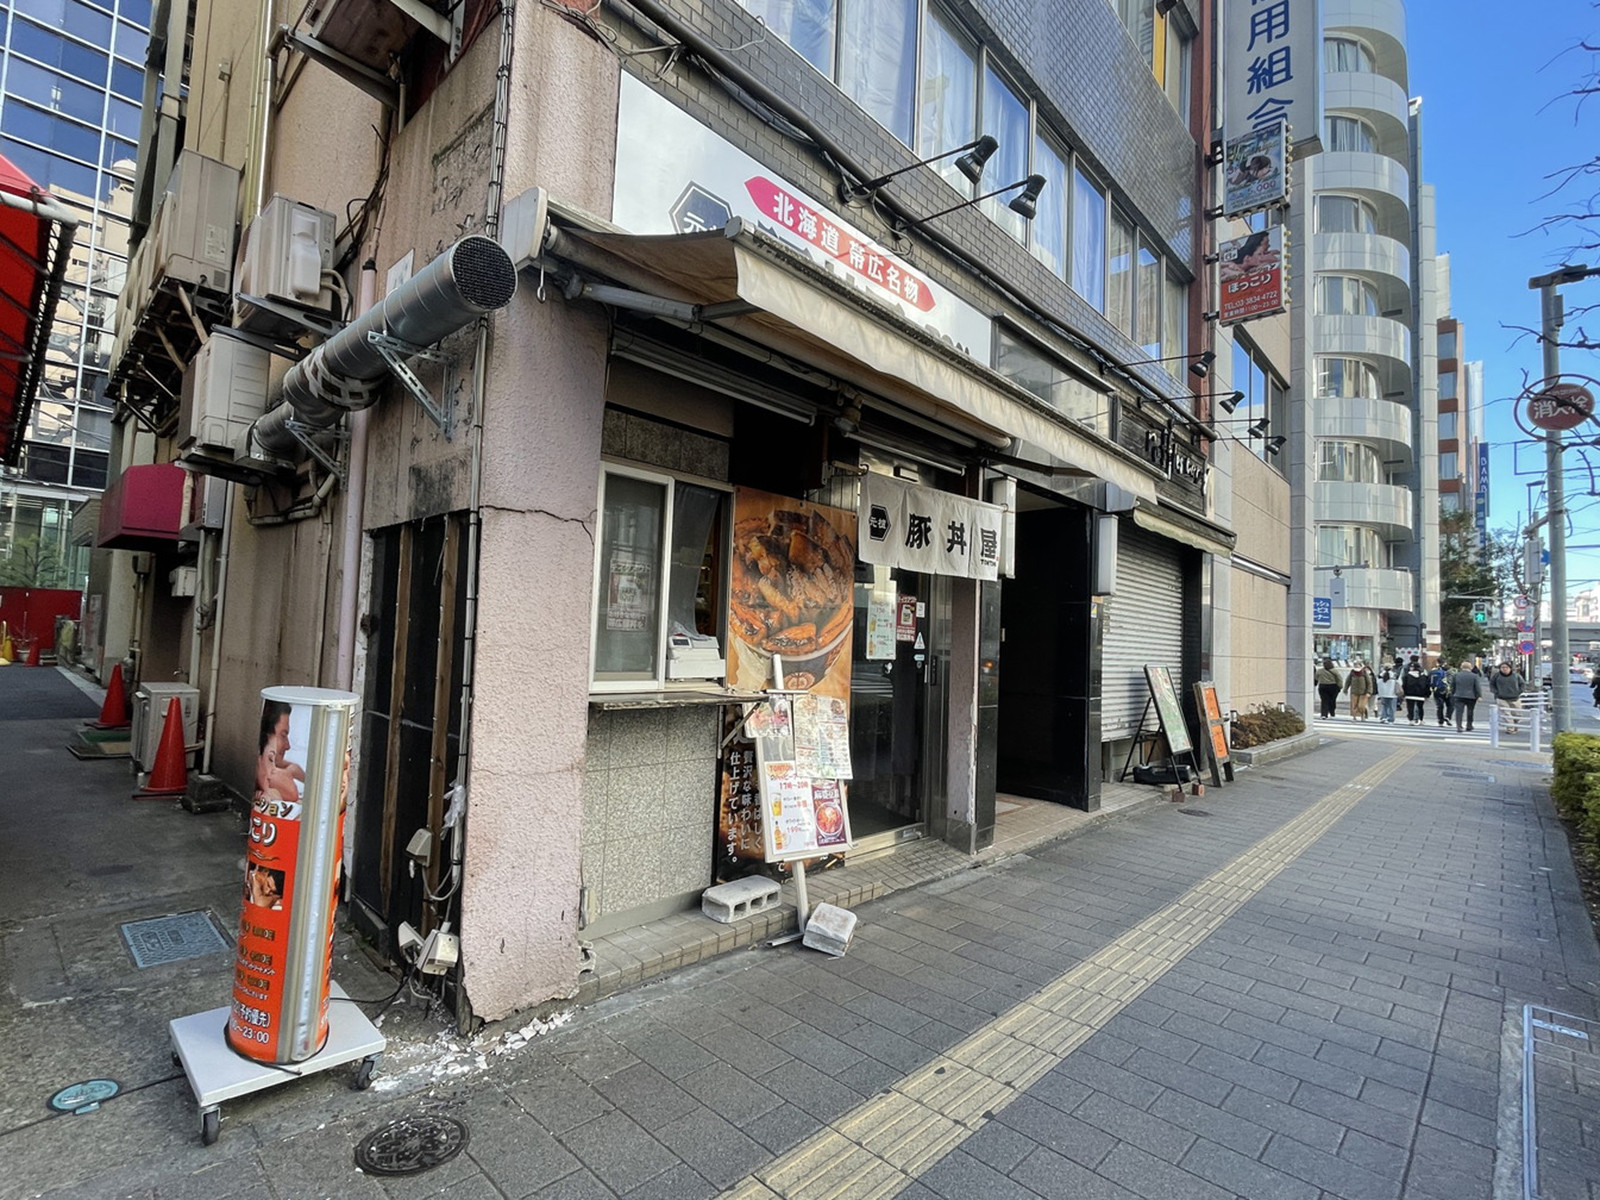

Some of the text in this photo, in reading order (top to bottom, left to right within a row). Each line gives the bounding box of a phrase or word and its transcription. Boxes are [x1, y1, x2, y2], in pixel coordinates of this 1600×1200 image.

[773, 192, 840, 255] 北海道
[849, 240, 919, 303] 帯広名物
[727, 752, 740, 863] 仕上げています。
[741, 751, 753, 850] 贅沢な味わいに
